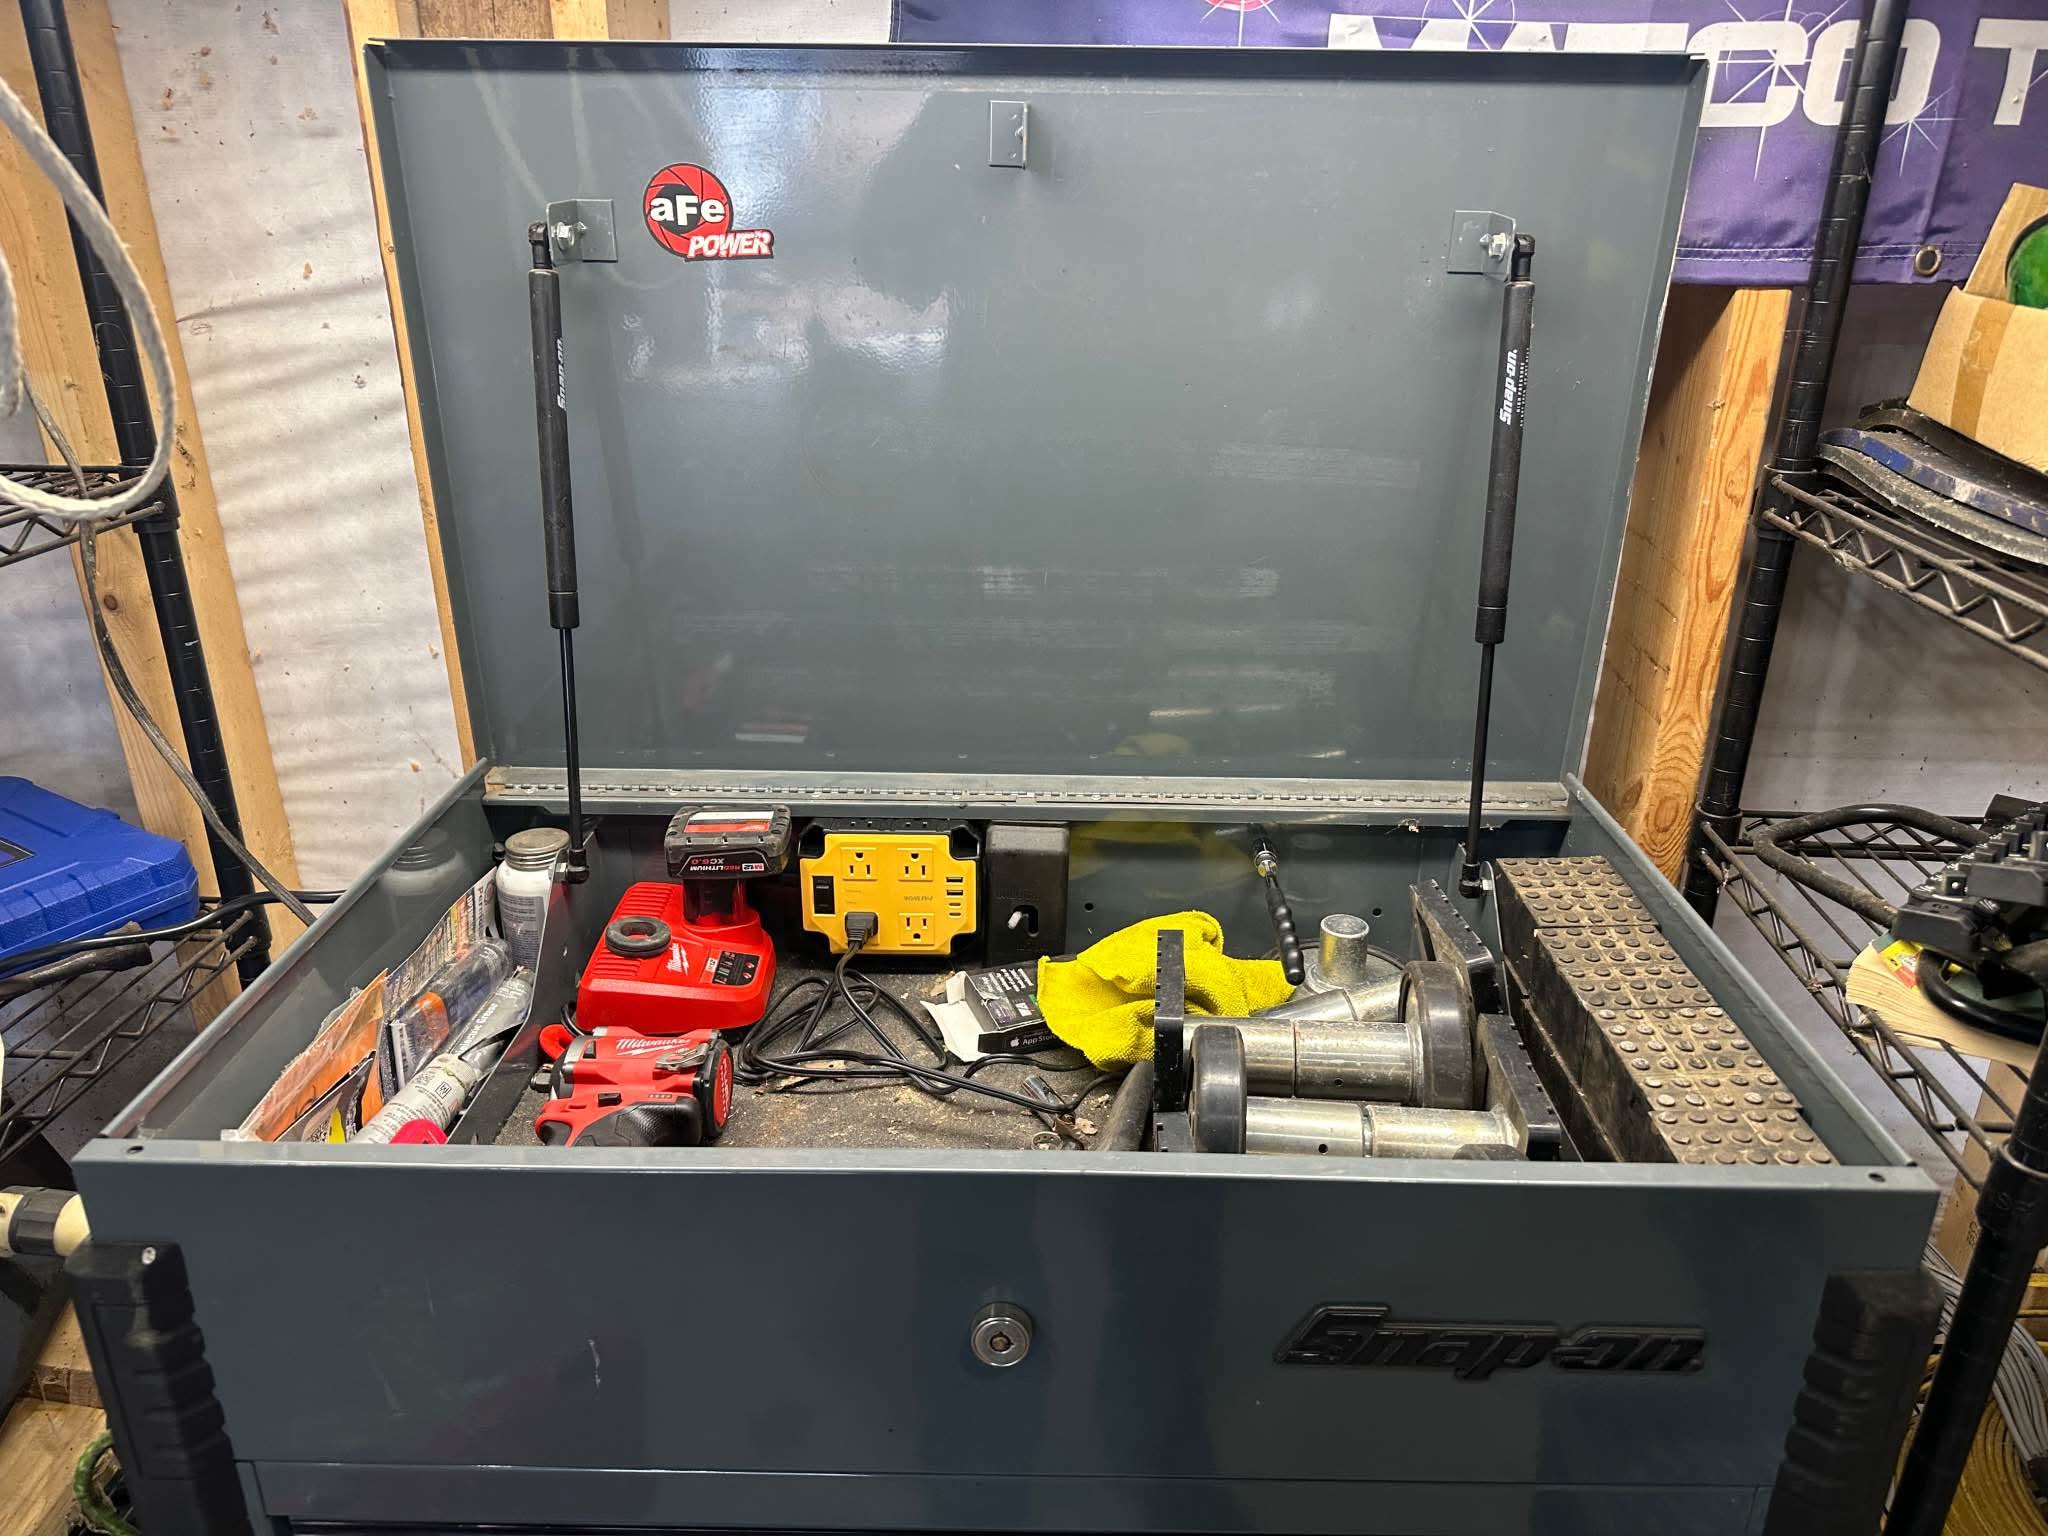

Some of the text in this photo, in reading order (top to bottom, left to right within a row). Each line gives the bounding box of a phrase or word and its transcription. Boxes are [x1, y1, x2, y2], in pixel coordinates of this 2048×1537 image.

[649, 194, 725, 226] aFe
[687, 231, 772, 258] POWER
[615, 1038, 691, 1050] Milwaukee
[1023, 1038, 1038, 1046] App
